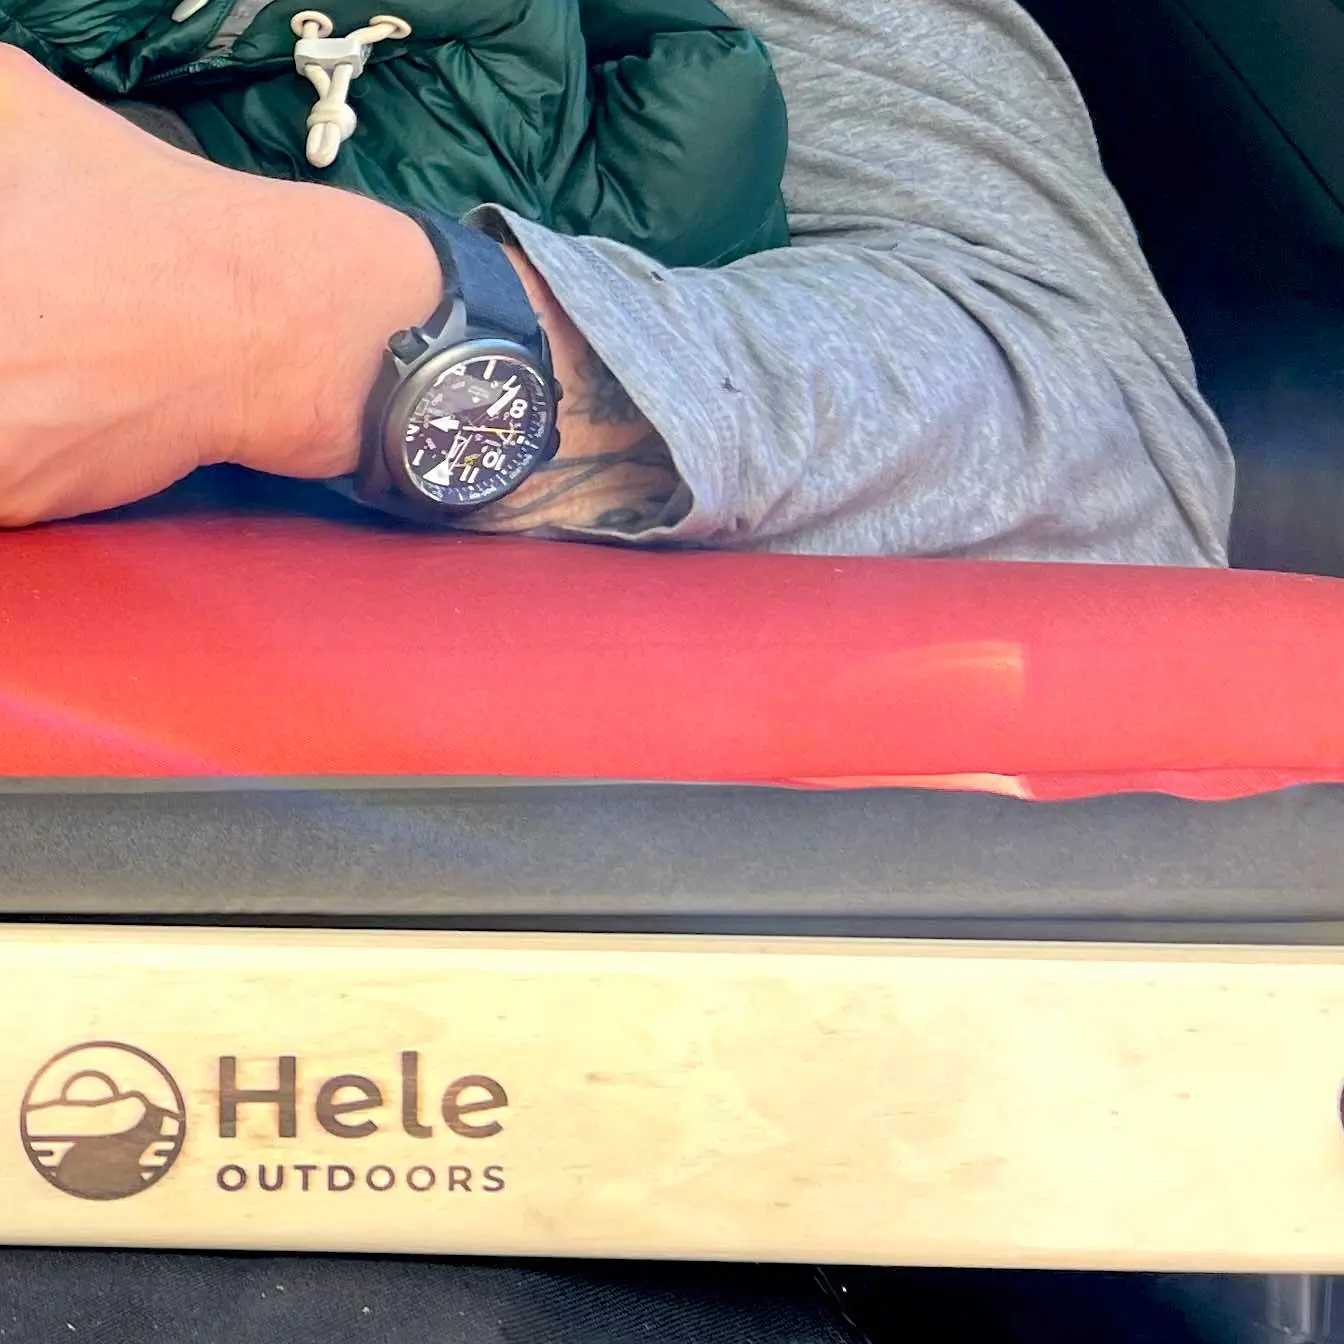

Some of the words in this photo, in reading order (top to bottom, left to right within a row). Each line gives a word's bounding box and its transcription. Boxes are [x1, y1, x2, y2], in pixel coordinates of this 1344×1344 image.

[509, 398, 528, 419] 8
[218, 1050, 508, 1139] Hele
[216, 1163, 506, 1192] OUTDOORS
